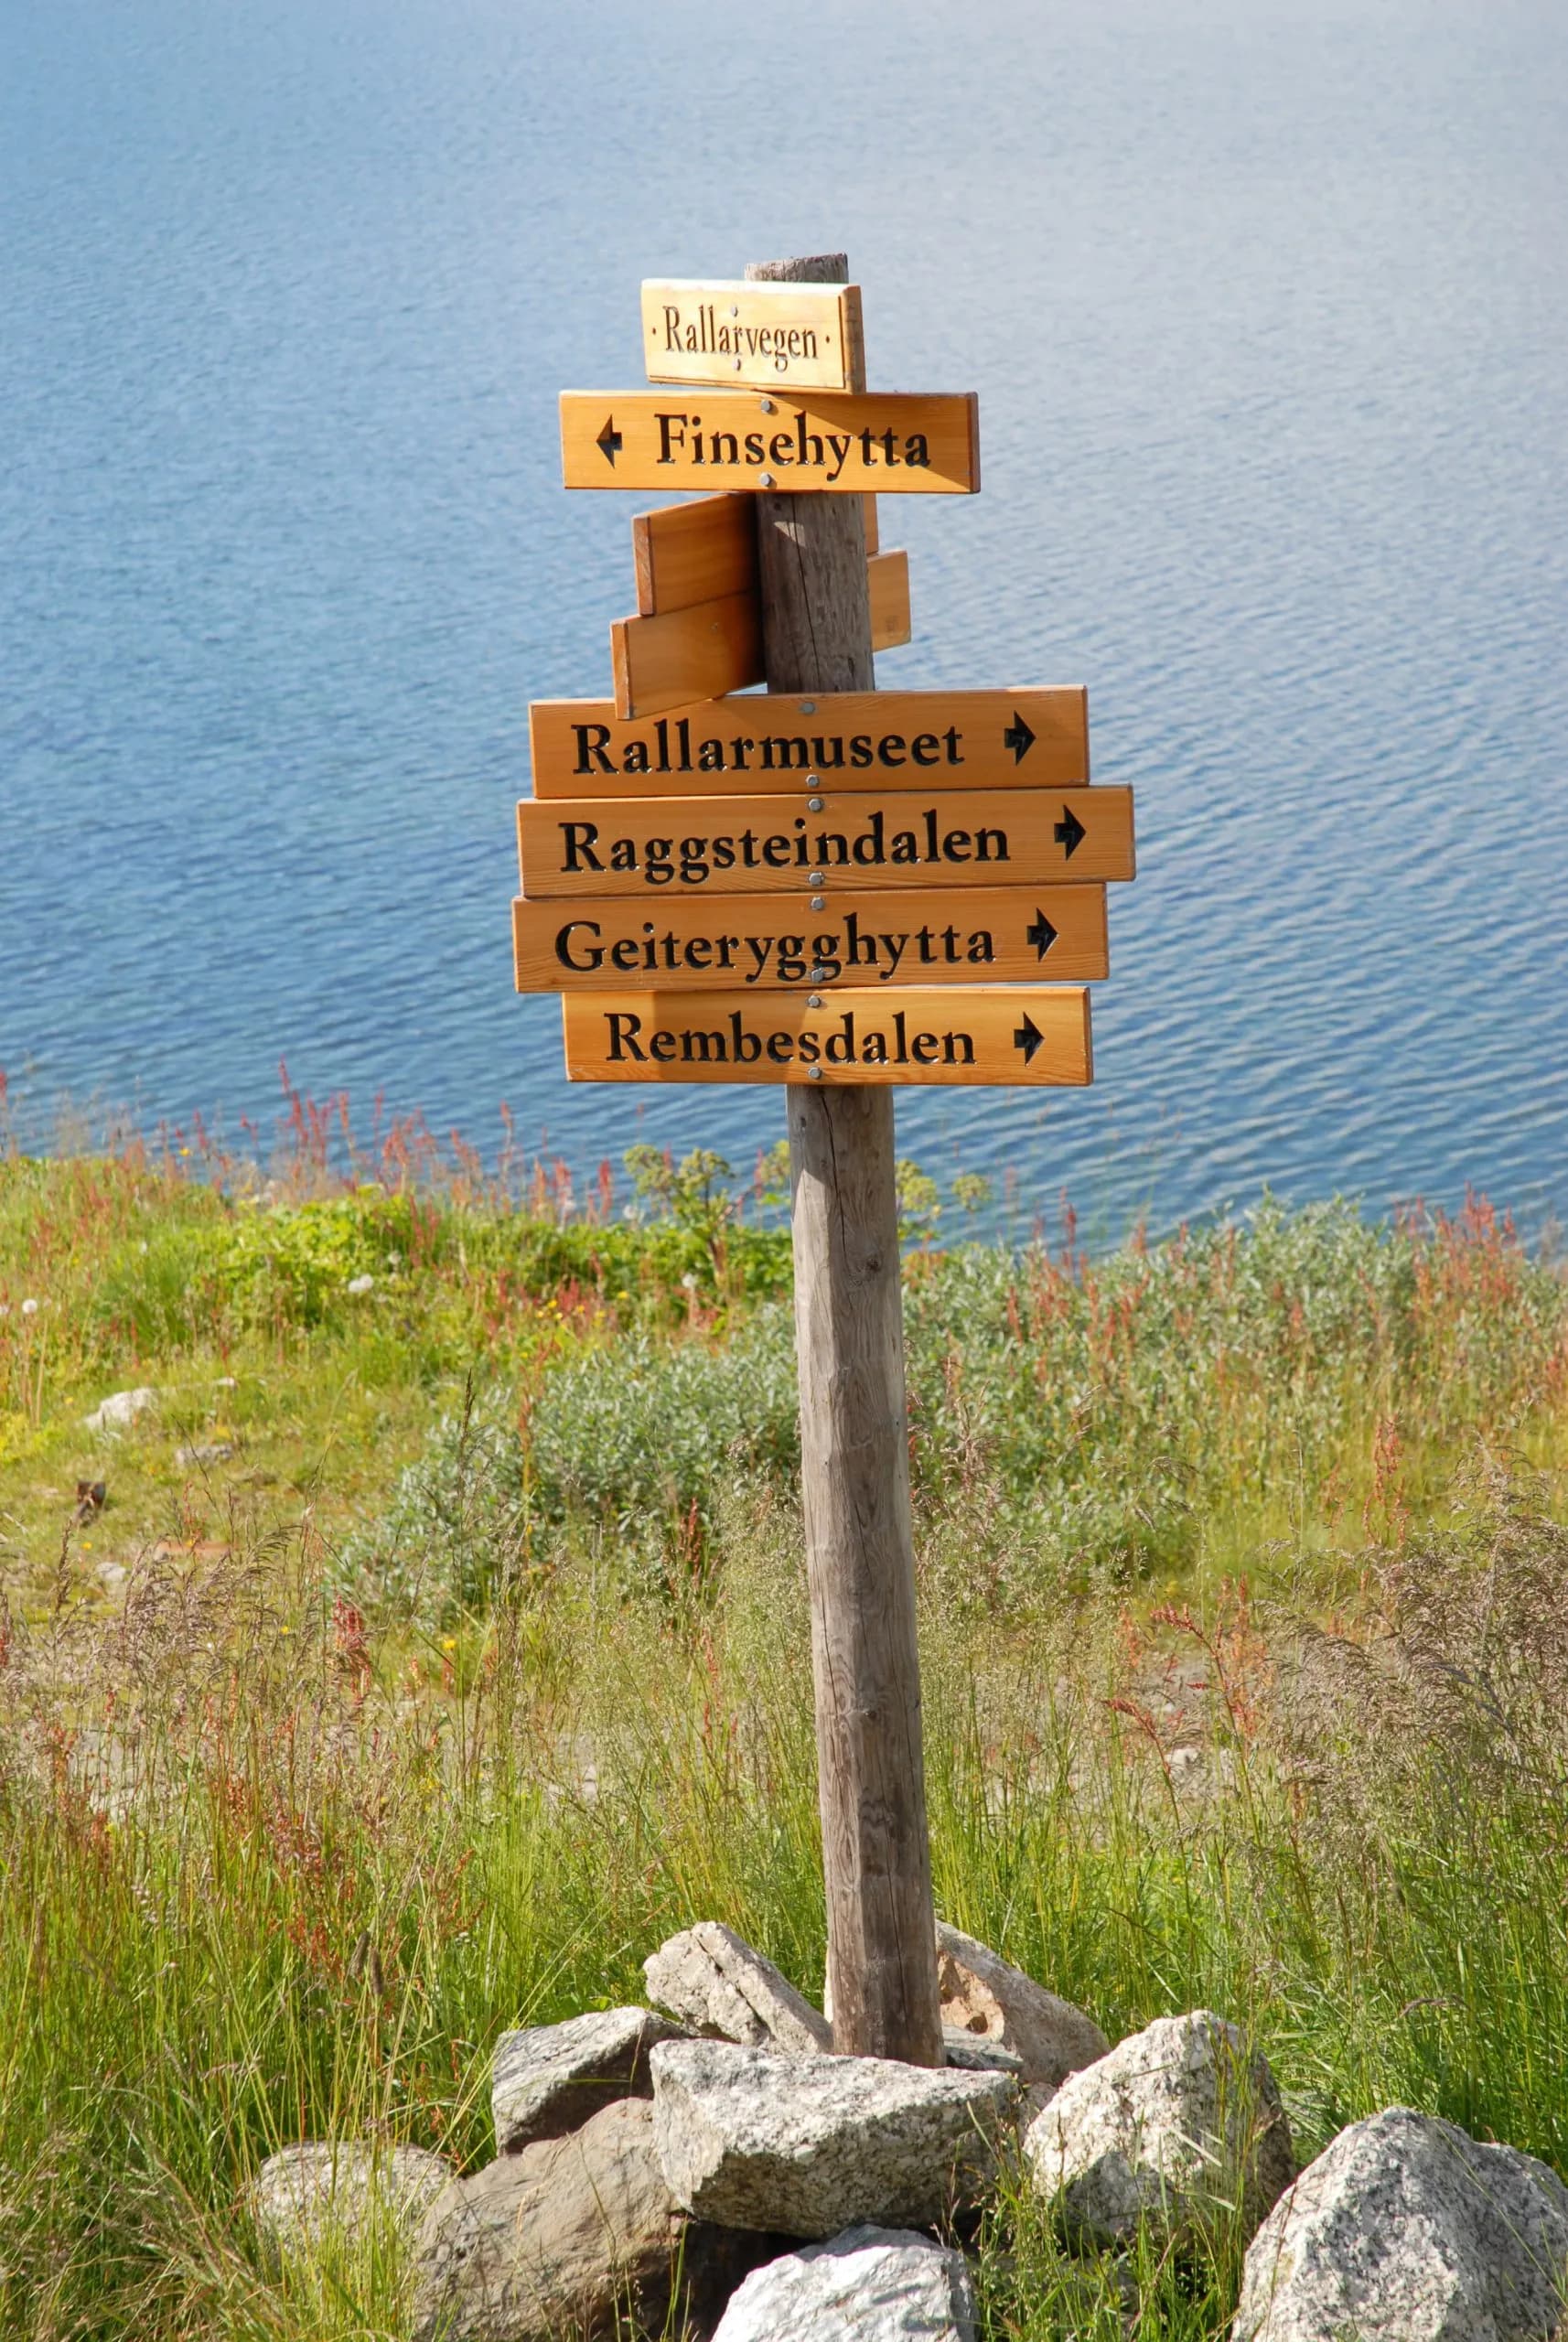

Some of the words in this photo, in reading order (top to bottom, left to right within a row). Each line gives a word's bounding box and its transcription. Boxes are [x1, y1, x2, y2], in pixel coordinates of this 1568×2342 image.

[662, 304, 818, 372] Rallarvegen
[654, 411, 931, 481] Finsehytta
[570, 718, 965, 775] Rallarmuseet
[557, 809, 1011, 885] Raggsteindalen
[554, 912, 996, 983] Geiterygghytta
[604, 1010, 977, 1066] Rembesdalen
